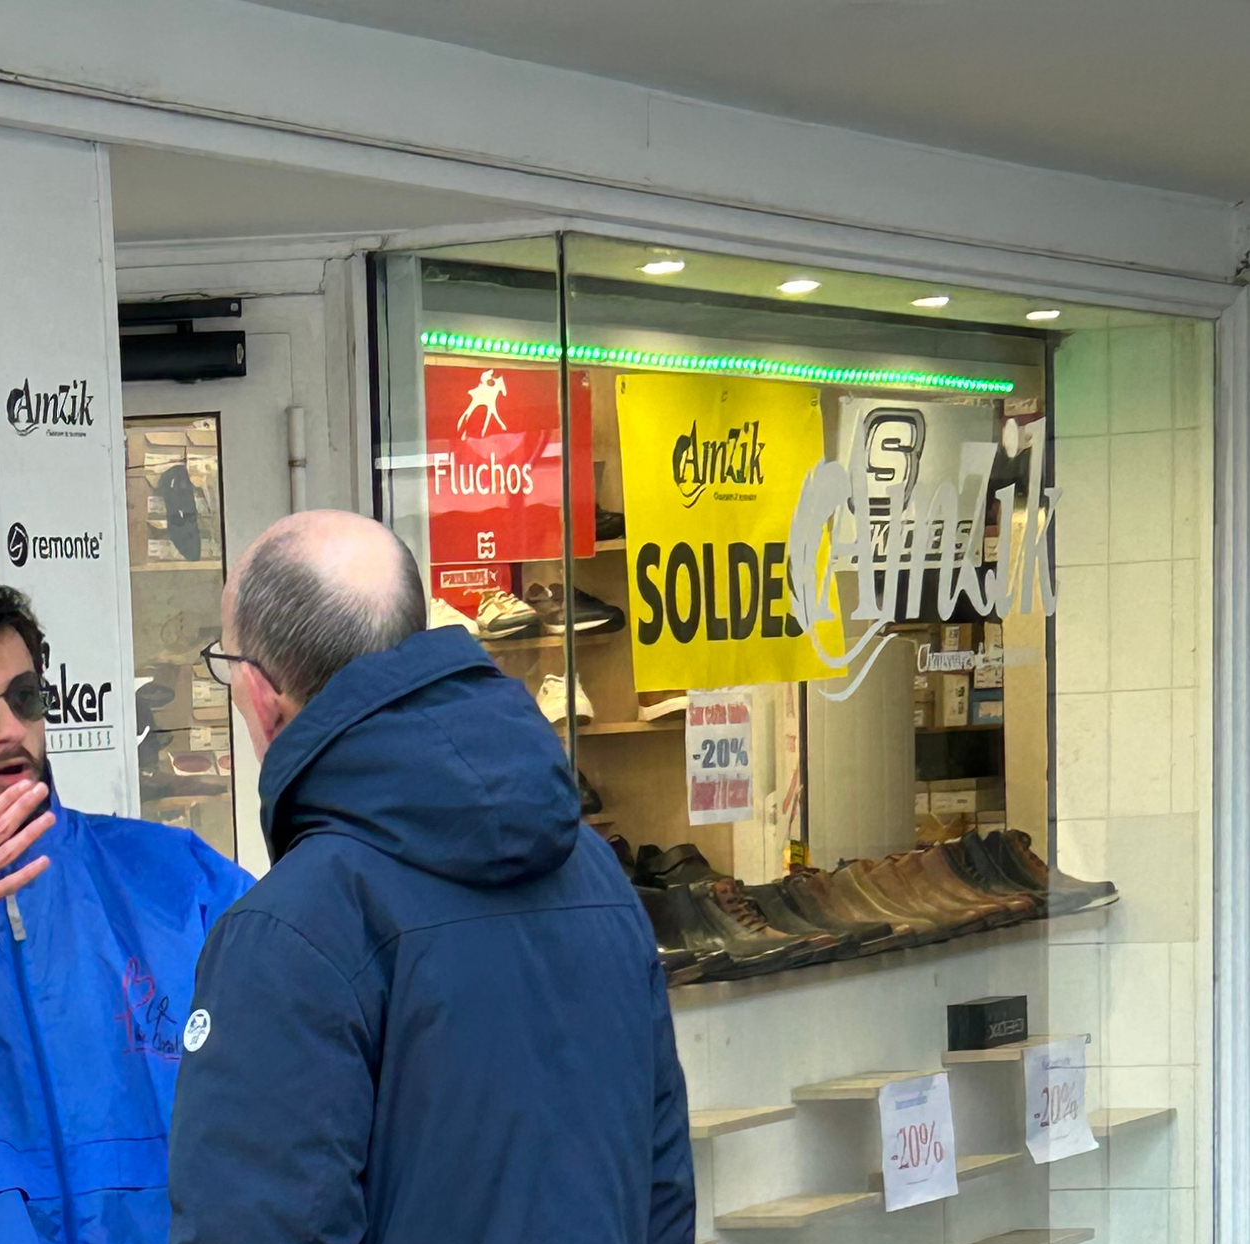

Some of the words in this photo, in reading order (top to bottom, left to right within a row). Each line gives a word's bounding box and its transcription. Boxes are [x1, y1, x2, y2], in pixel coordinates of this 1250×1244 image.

[6, 377, 95, 436] Amzik
[434, 451, 534, 496] Fluchos
[672, 420, 765, 508] Amzik
[32, 532, 100, 560] remonte
[42, 642, 112, 724] eker
[692, 737, 749, 769] -20%
